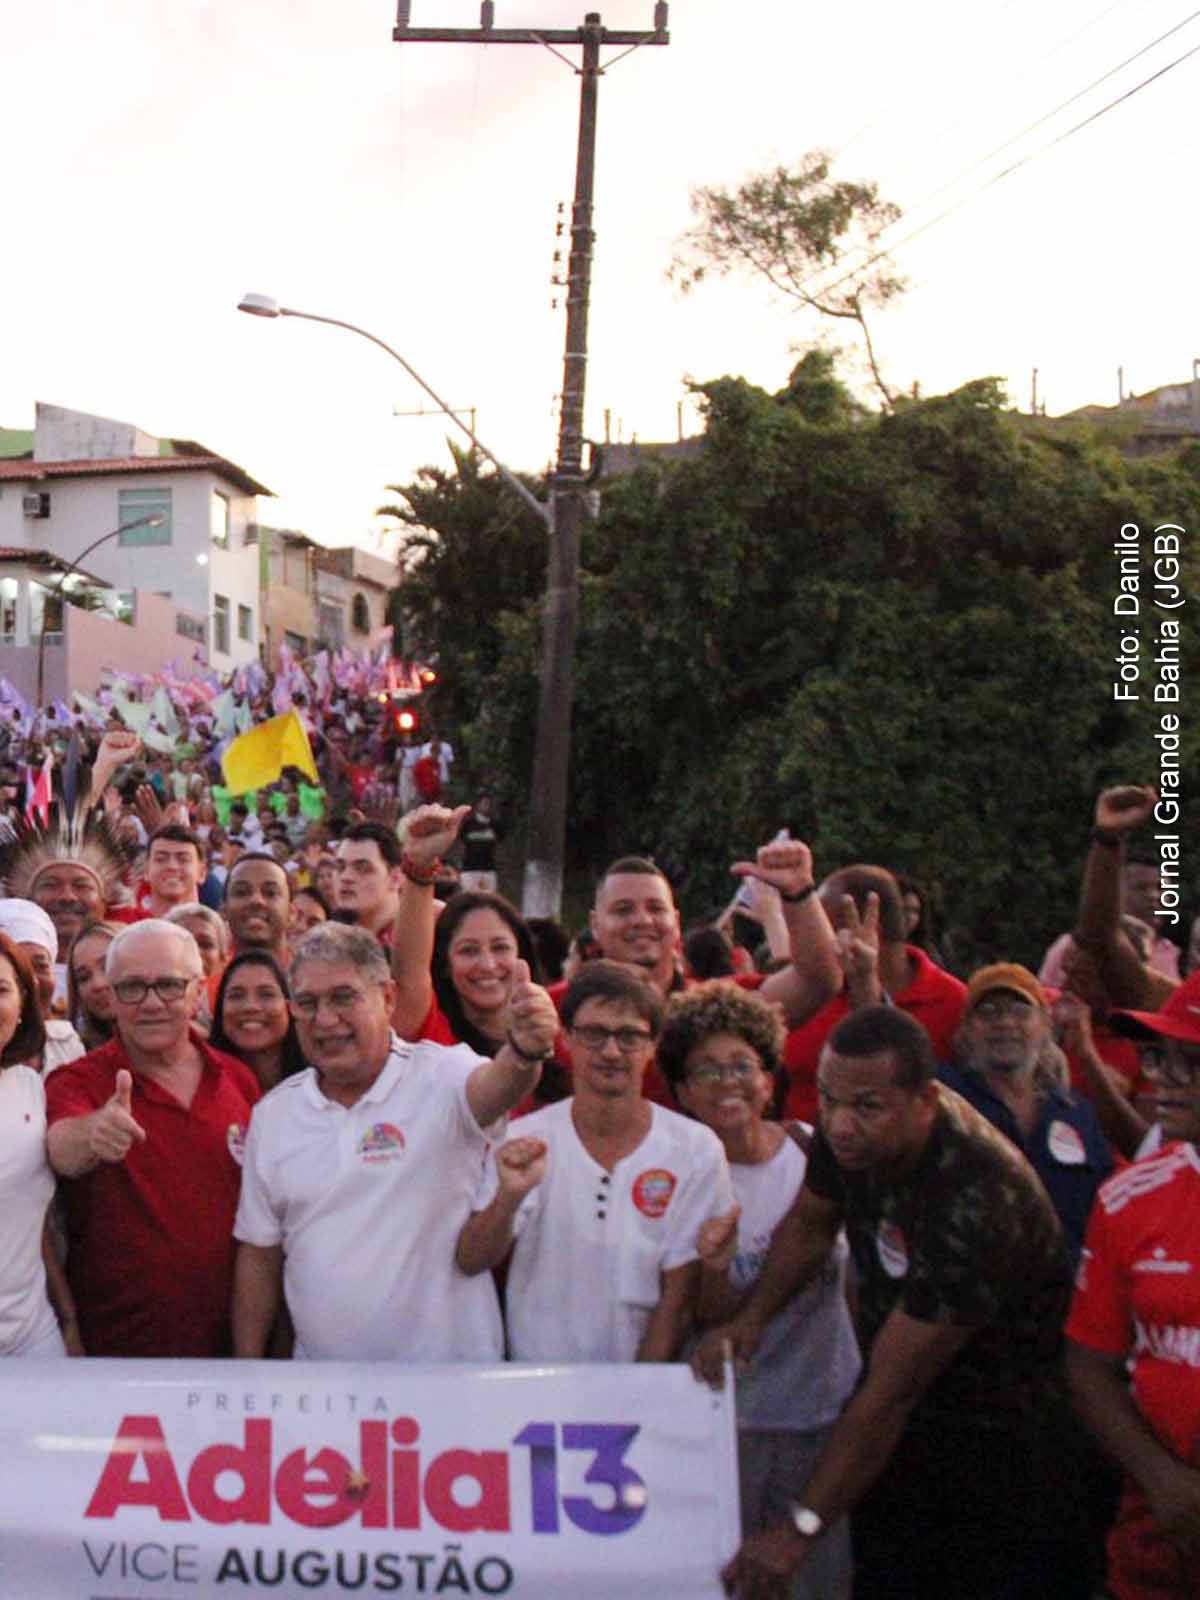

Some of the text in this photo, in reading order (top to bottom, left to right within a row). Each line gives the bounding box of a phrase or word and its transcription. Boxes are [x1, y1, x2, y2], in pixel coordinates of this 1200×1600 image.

[187, 1391, 390, 1413] PREFEITA
[81, 1539, 515, 1597] VICE AUGUSTÃO
